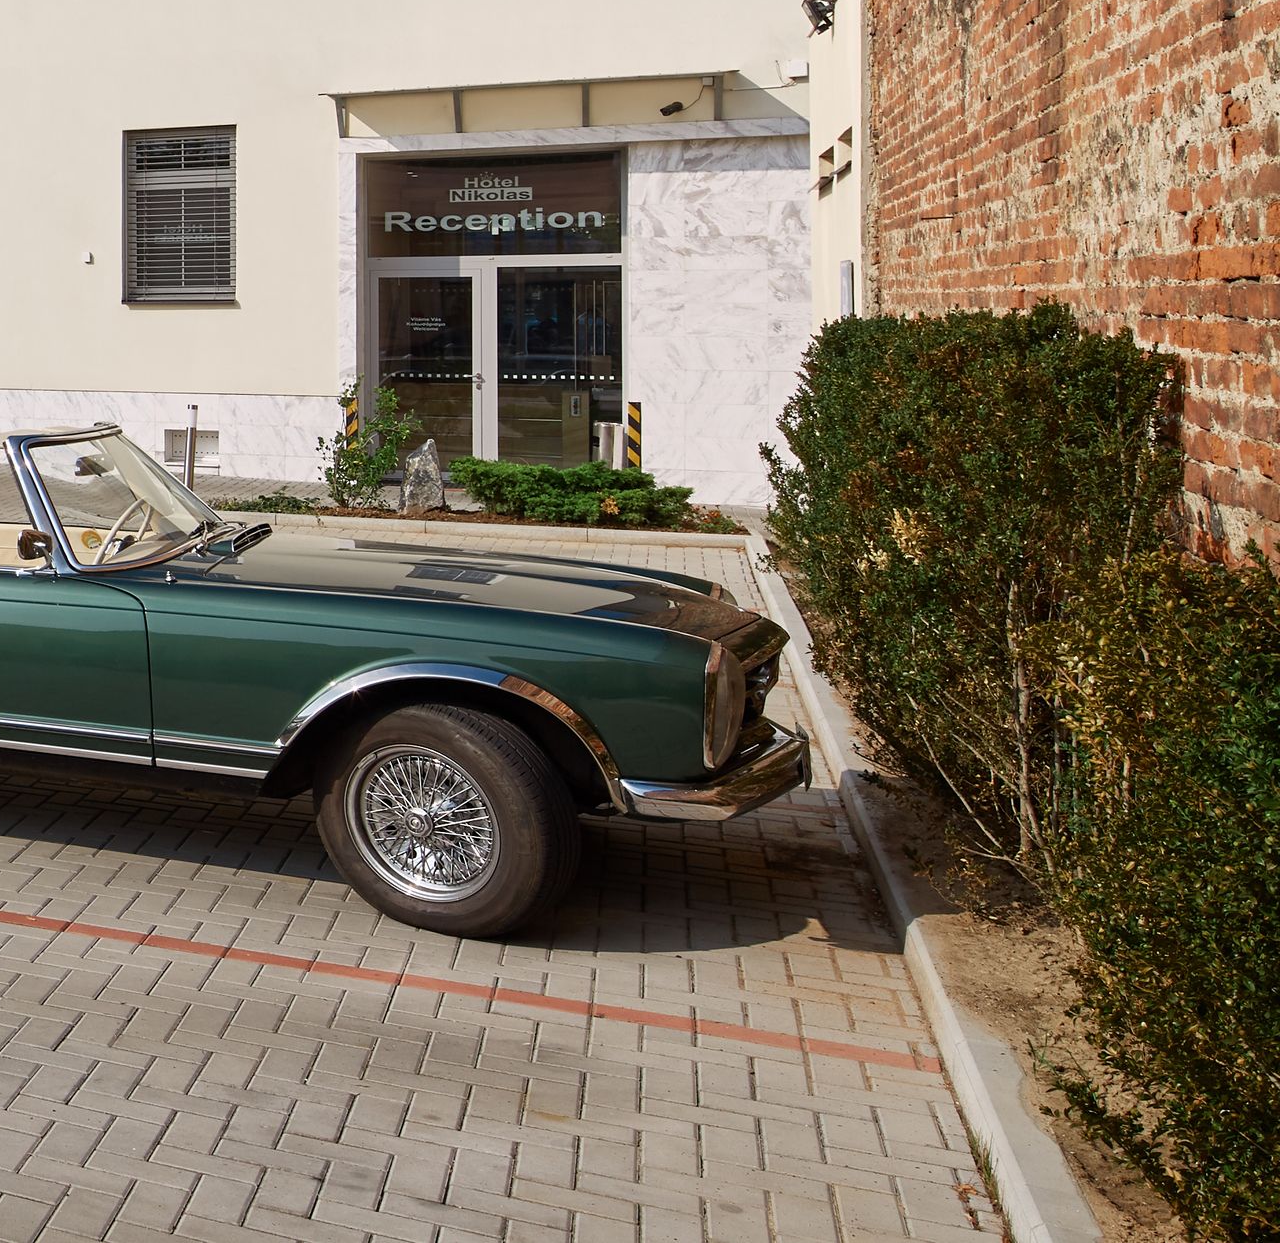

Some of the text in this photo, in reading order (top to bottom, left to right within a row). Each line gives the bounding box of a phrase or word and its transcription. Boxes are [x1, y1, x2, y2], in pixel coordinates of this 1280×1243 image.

[464, 176, 519, 188] Hotel
[451, 189, 530, 202] Nikolas
[384, 207, 602, 235] Reception
